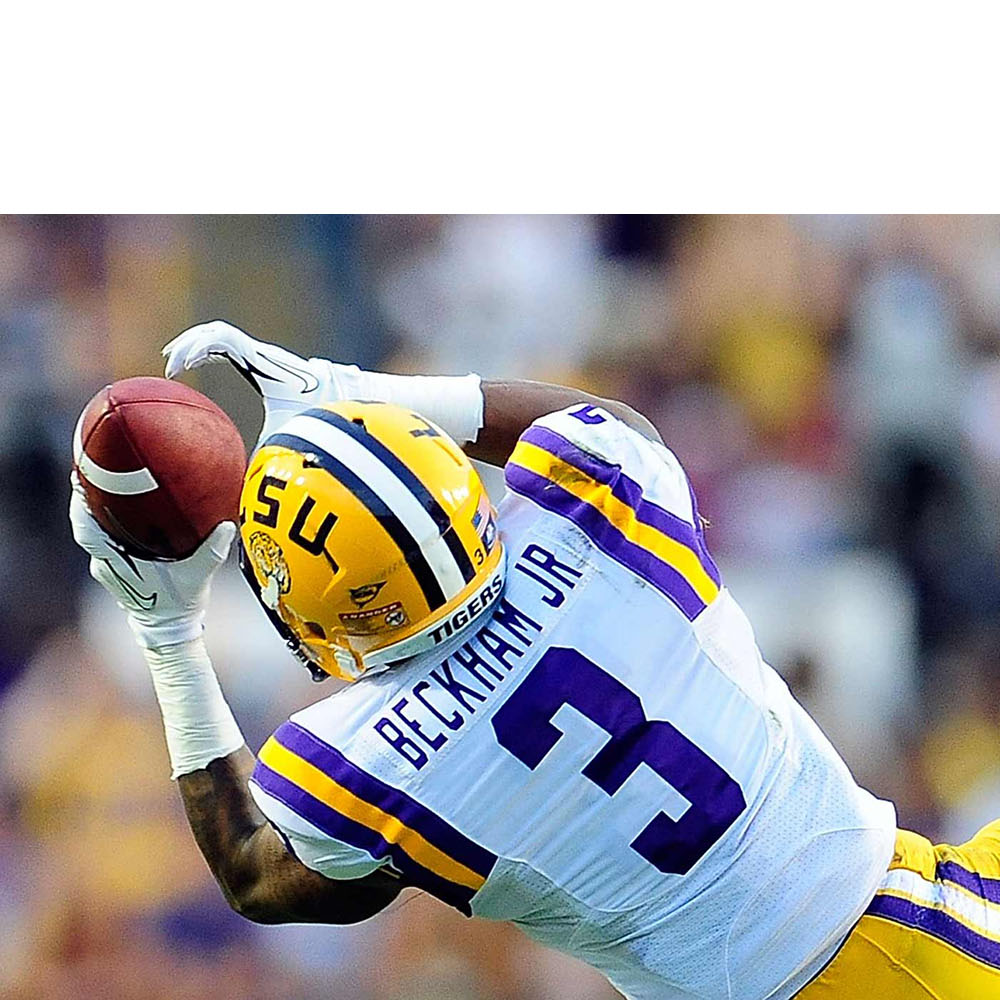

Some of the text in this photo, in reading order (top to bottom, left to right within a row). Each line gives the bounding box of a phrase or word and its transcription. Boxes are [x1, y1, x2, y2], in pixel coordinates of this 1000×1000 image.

[427, 574, 503, 645] TIGERS
[474, 548, 484, 566] 3
[374, 543, 583, 771] BECKHAM JR
[490, 645, 748, 877] 3
